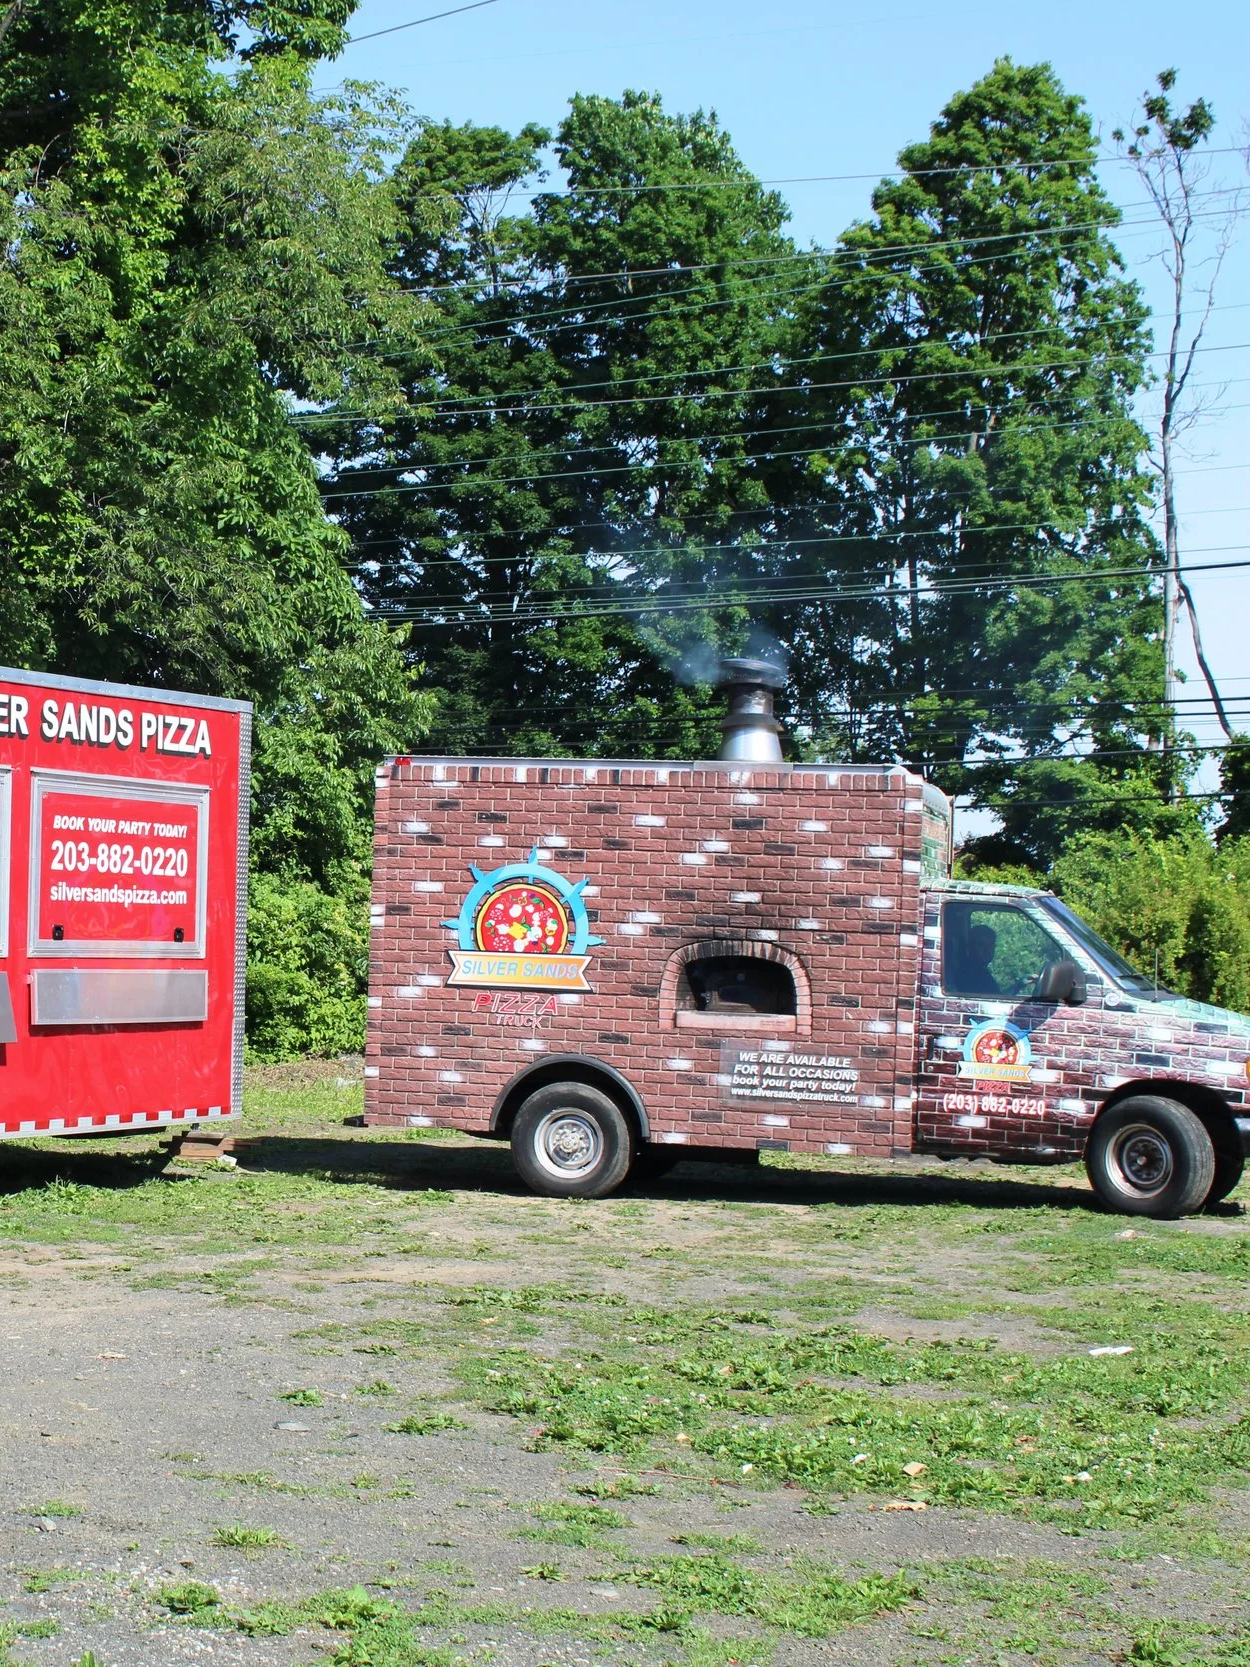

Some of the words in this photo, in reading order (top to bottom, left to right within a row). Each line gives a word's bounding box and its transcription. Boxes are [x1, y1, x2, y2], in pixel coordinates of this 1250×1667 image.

[41, 699, 133, 748] SANDS
[140, 712, 212, 758] PIZZA
[53, 815, 85, 831] BOOK
[88, 817, 116, 833] YOUR
[118, 820, 151, 836] PARTY
[153, 823, 188, 838] TODAY!
[50, 840, 188, 877] 203-882-0220
[50, 881, 187, 908] silversandspizza.com
[462, 959, 519, 976] SILVER
[522, 962, 579, 979] SANDS
[472, 992, 558, 1015] PIZZA
[495, 1013, 542, 1029] TRUCK
[739, 1052, 759, 1062] WE
[759, 1054, 786, 1064] ARE
[786, 1055, 851, 1068] AVAILABLE
[734, 1064, 759, 1074] FOR
[763, 1066, 787, 1077] ALL
[789, 1068, 858, 1080] OCCASIONS
[732, 1075, 760, 1085] book
[762, 1078, 789, 1088] your
[790, 1080, 822, 1091] party
[821, 1081, 856, 1093] today!
[975, 1080, 1009, 1092] PIZZA
[731, 1087, 858, 1103] www.silversandspizzatruck.com
[943, 1093, 978, 1114] (203)
[981, 1097, 1045, 1115] 882-0220
